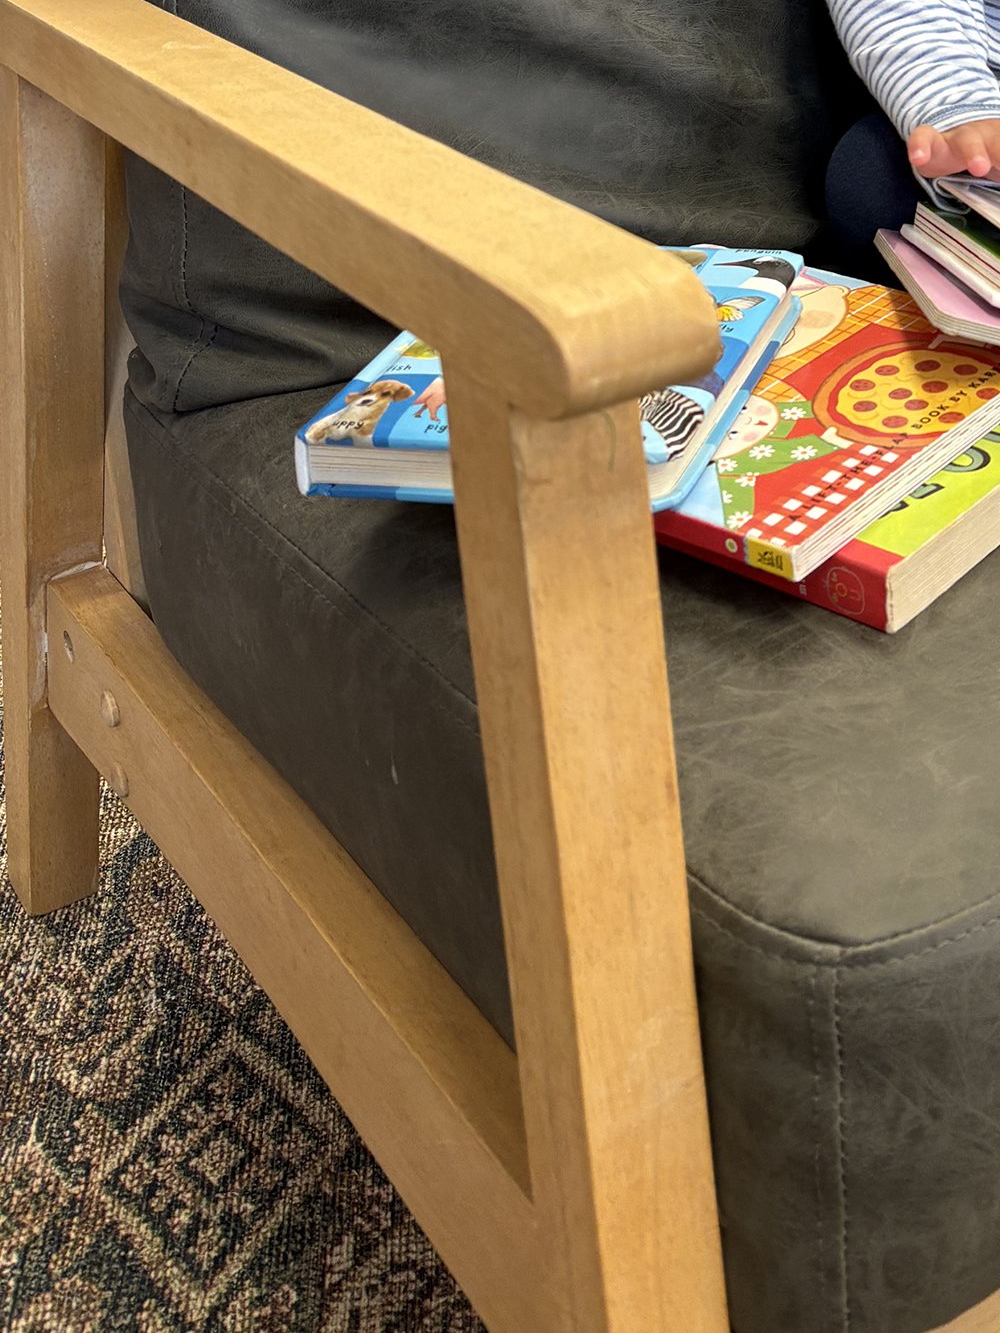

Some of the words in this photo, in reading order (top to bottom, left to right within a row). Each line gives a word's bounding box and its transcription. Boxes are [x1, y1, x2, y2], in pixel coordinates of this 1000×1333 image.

[424, 423, 448, 433] pig
[787, 514, 802, 522] A
[910, 404, 949, 430] BOOK
[949, 389, 968, 403] BY
